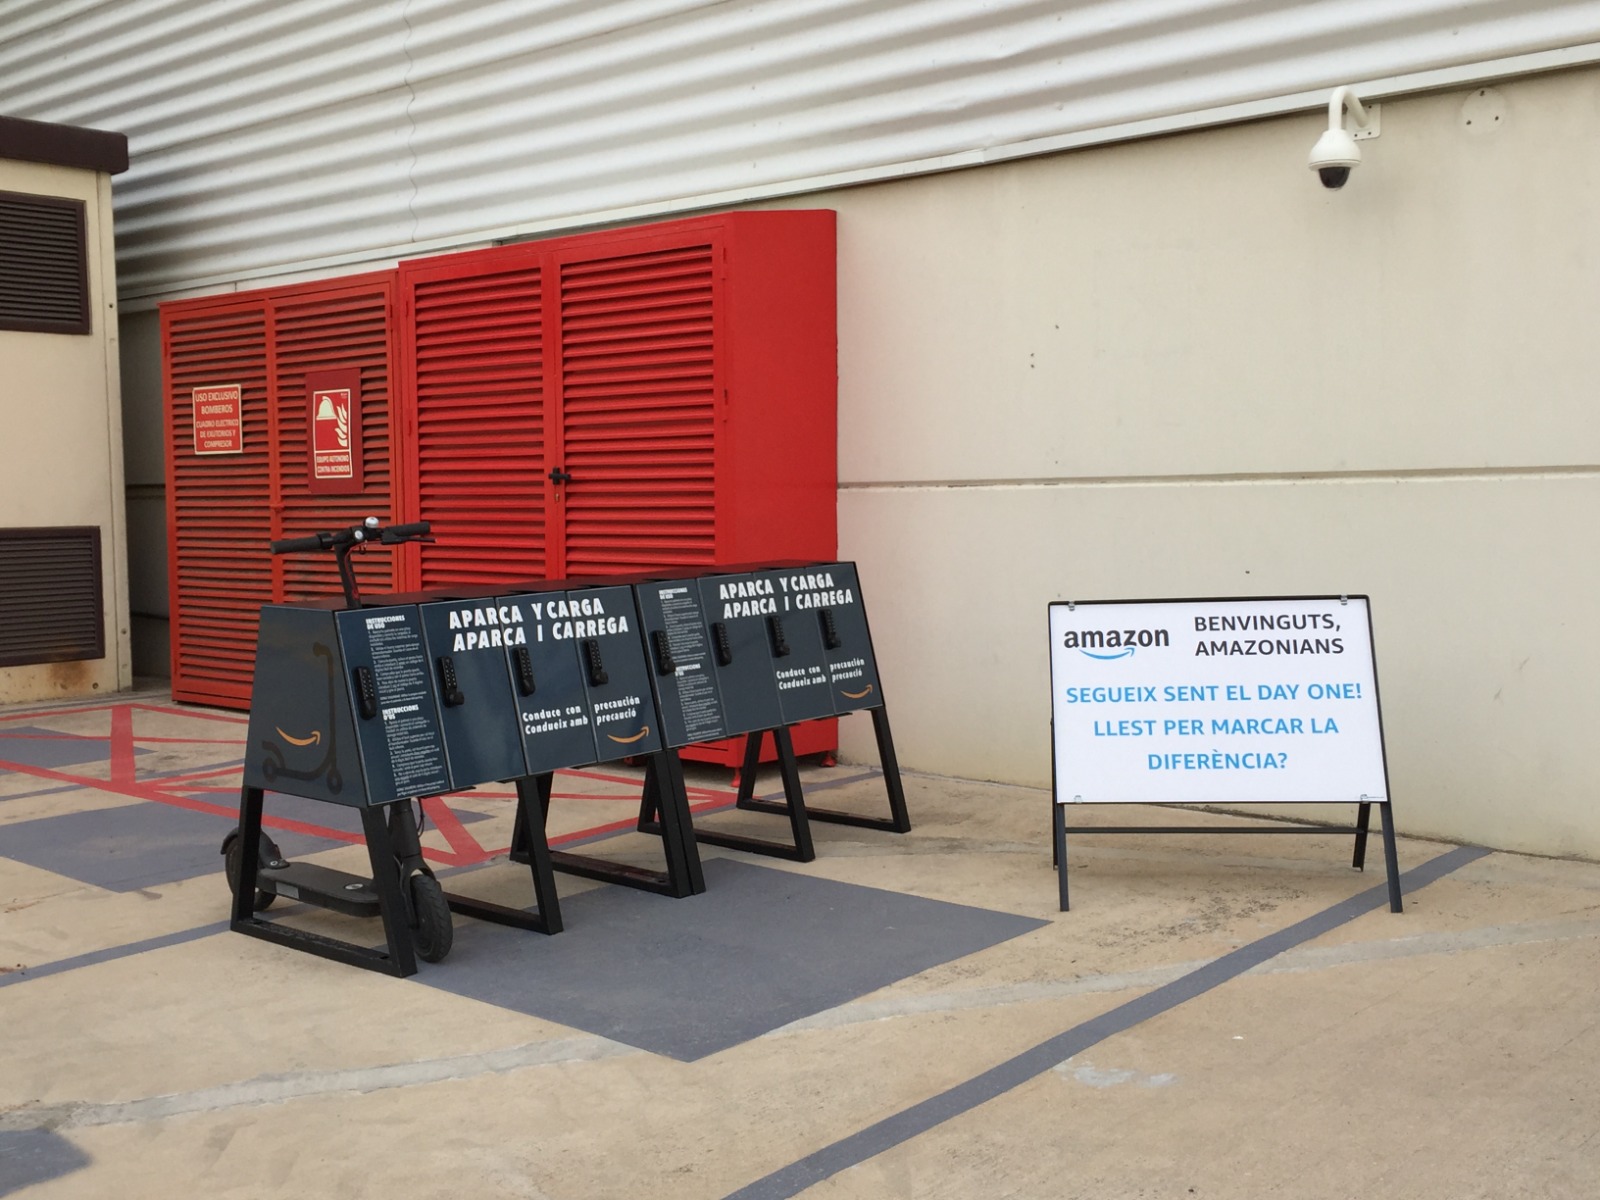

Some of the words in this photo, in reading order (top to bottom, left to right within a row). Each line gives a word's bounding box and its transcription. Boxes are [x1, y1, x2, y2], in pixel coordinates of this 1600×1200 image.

[195, 392, 207, 402] USO
[208, 391, 238, 401] EXCLUSIVO
[201, 404, 233, 414] BOMBEROS
[719, 579, 774, 600] APARCA
[779, 577, 788, 592] Y
[791, 573, 834, 591] CARGA
[449, 606, 523, 629] APARCA
[531, 603, 542, 620] Y
[546, 598, 604, 619] CARGA
[723, 598, 776, 619] APARCA
[785, 596, 789, 611] I
[796, 589, 853, 609] CARREGA
[366, 614, 405, 624] INSTRUCCIONES
[1194, 614, 1341, 632] BENVINGUTS,
[453, 627, 526, 652] APARCA
[537, 625, 543, 642] I
[552, 616, 629, 640] CARREGA
[1063, 628, 1170, 649] amazon
[1195, 638, 1344, 657] AMAZONIANS
[776, 669, 806, 680] Conduce
[808, 665, 820, 674] con
[830, 658, 865, 672] precaución
[779, 678, 811, 690] Condueix
[812, 674, 826, 684] amb
[832, 669, 863, 683] precaució
[1066, 686, 1157, 703] SEGUEIX
[1164, 685, 1219, 702] SENT
[1226, 685, 1250, 701] EL
[1258, 684, 1299, 700] DAY
[1307, 683, 1361, 699] ONE!
[522, 710, 561, 722] Conduce
[566, 705, 581, 715] con
[594, 696, 640, 714] precaución
[525, 720, 568, 735] Condueix
[570, 716, 588, 727] amb
[597, 708, 637, 725] precaució
[1094, 720, 1157, 736] LLEST
[1164, 719, 1204, 735] PER
[1212, 718, 1304, 734] MARCAR
[1311, 718, 1338, 733] LA
[1148, 749, 1287, 770] DIFERÈNCIA?
